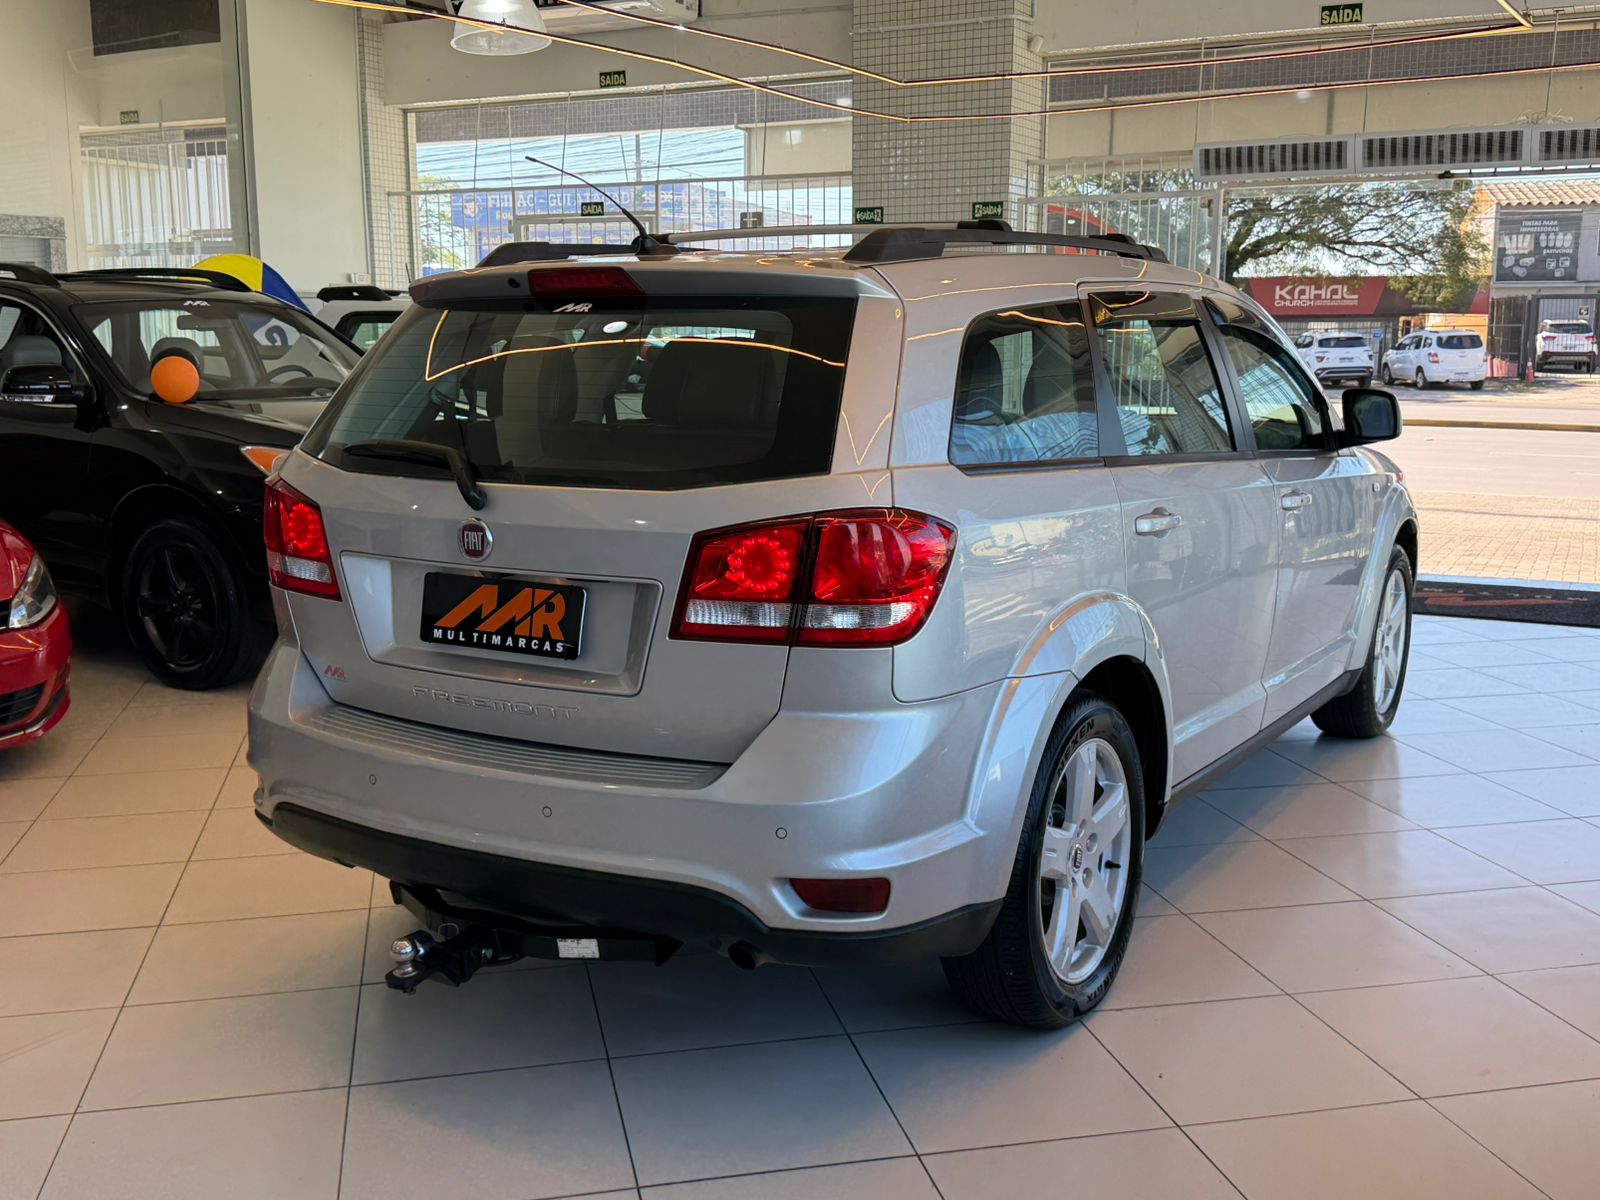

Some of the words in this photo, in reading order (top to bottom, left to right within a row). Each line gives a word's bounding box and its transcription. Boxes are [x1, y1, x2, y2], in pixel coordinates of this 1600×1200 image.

[1321, 5, 1361, 24] SAÍDA
[600, 71, 625, 86] SAÍDA
[582, 204, 603, 216] SAÍDA
[1275, 285, 1359, 300] KAHAL
[1274, 299, 1314, 307] CHURCH
[463, 530, 484, 551] FIAT
[433, 628, 565, 653] MULTIMARCAS
[411, 685, 581, 720] FREEMONT
[1056, 718, 1095, 778] NEXEN
